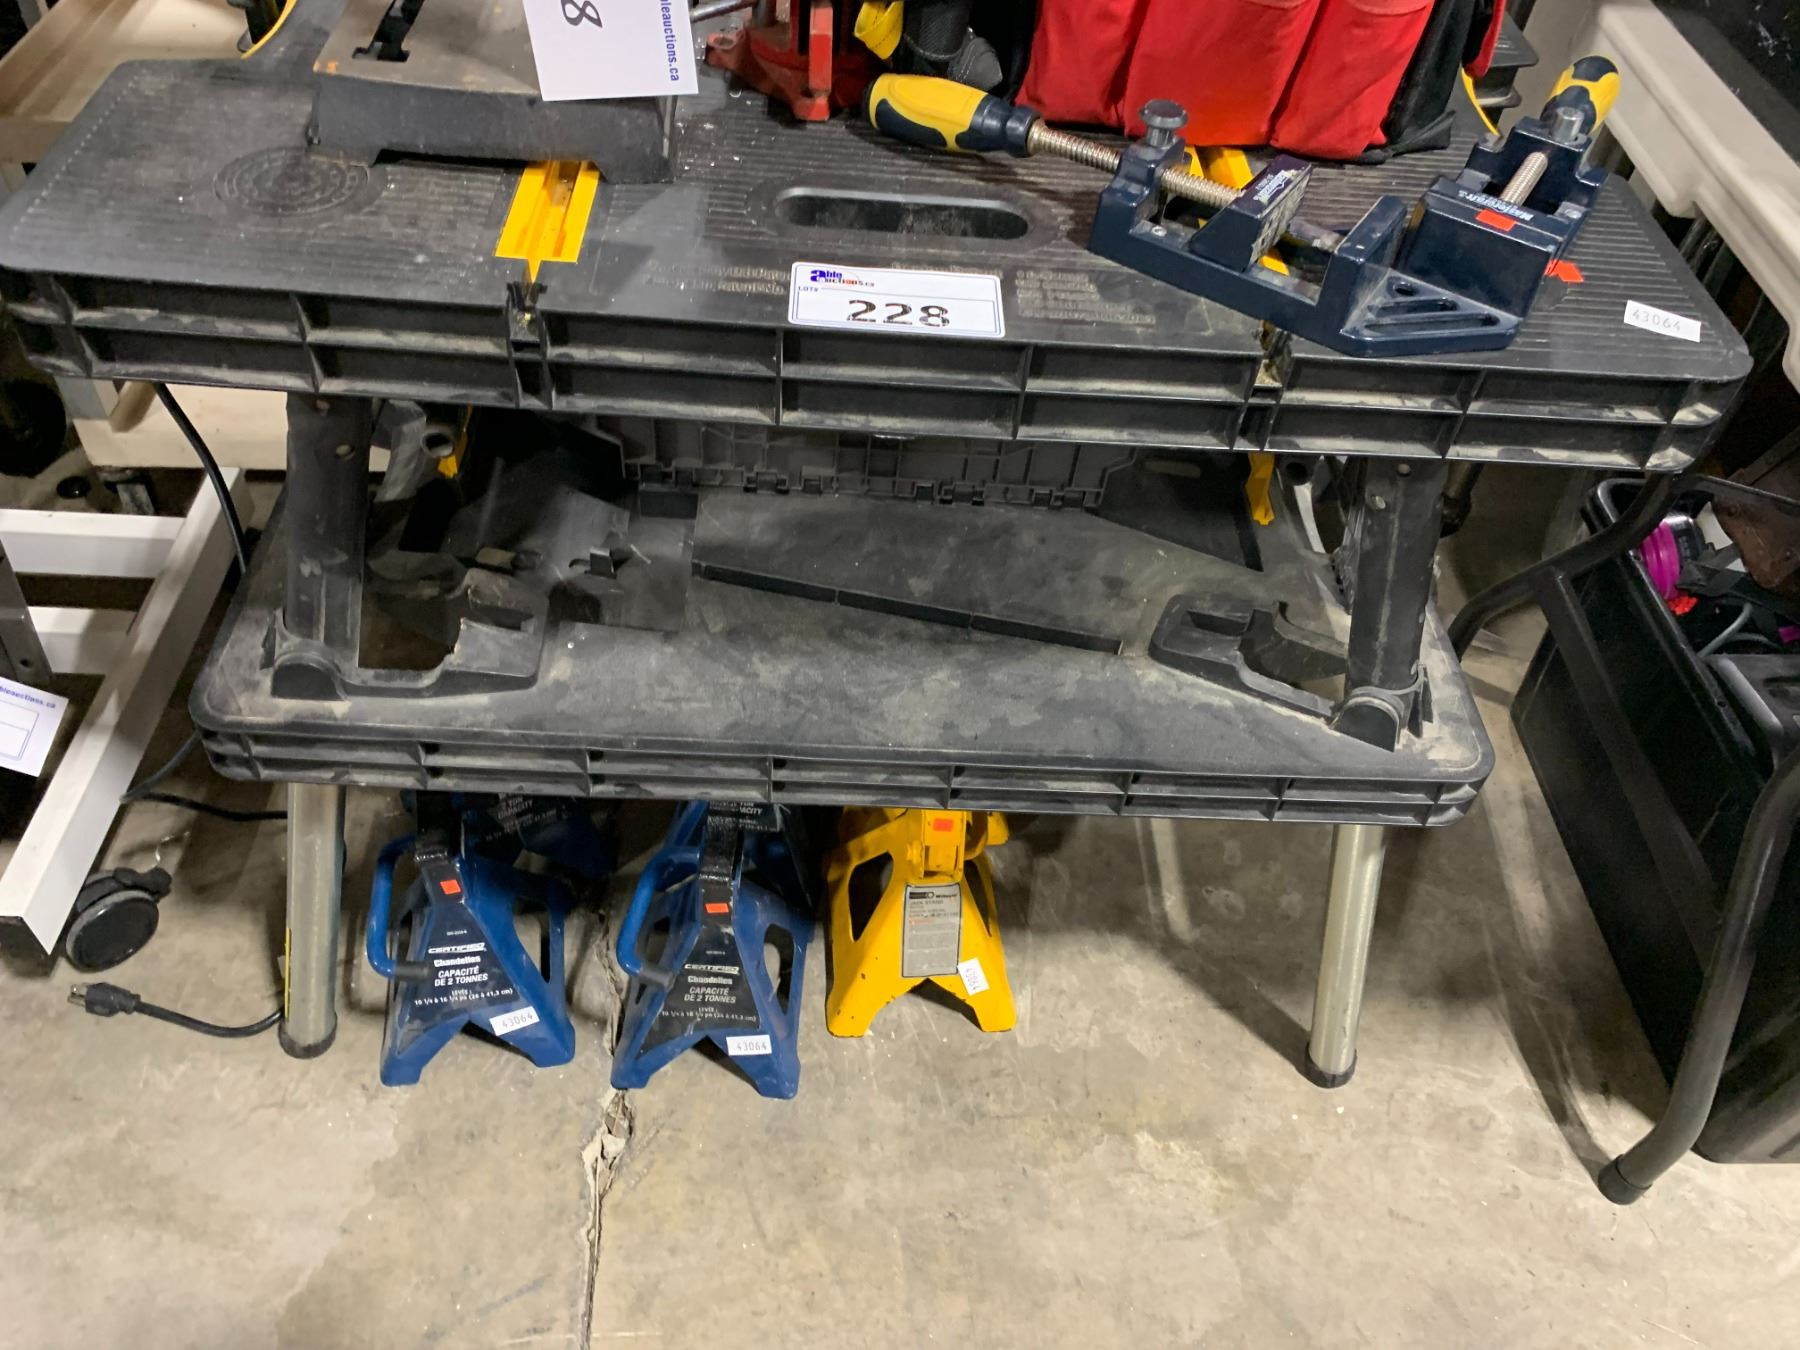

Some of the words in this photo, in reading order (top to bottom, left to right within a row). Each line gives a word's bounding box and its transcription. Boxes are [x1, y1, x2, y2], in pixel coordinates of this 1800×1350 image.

[660, 0, 679, 81] leauctions.ca
[847, 299, 950, 327] 228
[438, 966, 480, 979] CAPACITÉ
[434, 977, 446, 987] DE
[447, 977, 454, 986] 2
[455, 973, 489, 985] TONNES
[689, 986, 730, 996] CAPACITÉ
[684, 994, 695, 1002] DE
[695, 994, 702, 1002] 2
[704, 995, 736, 1004] TONNES
[501, 1010, 534, 1029] 43064
[736, 1040, 767, 1051] 43064
